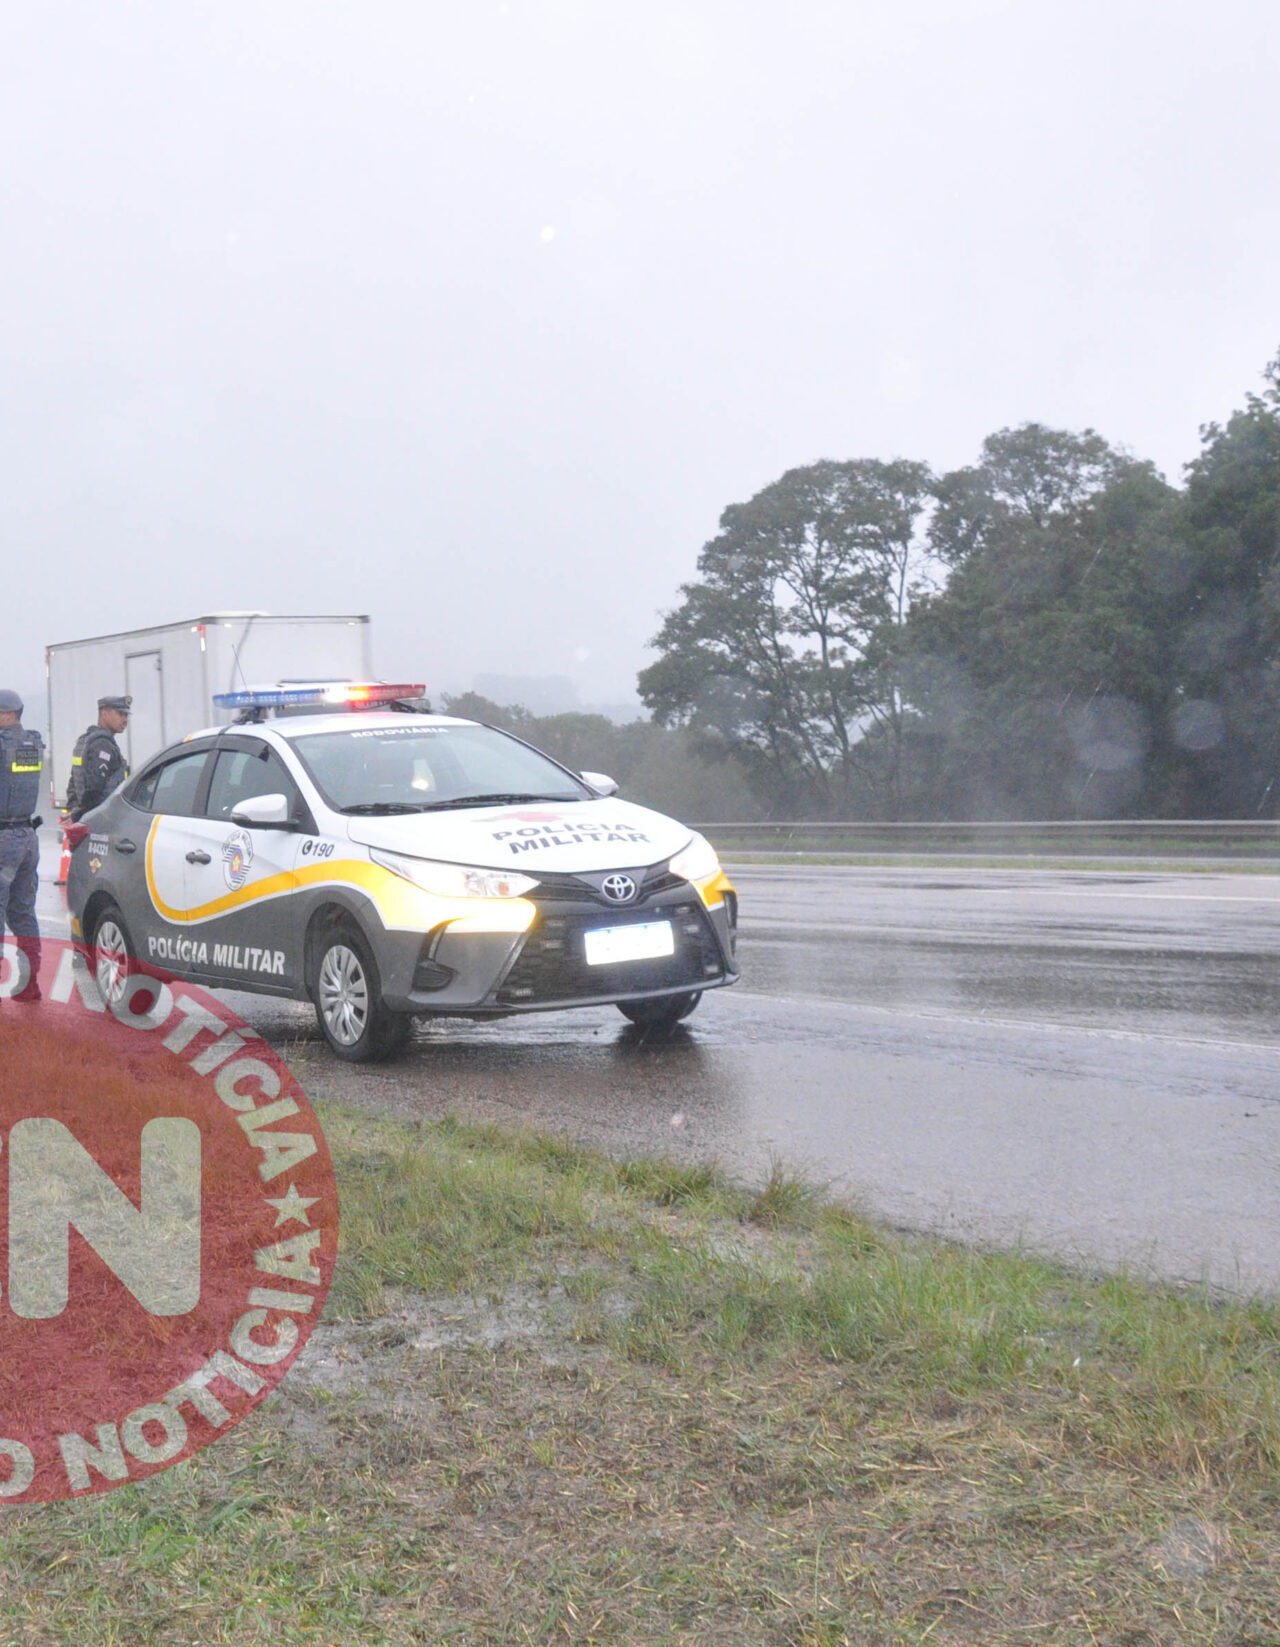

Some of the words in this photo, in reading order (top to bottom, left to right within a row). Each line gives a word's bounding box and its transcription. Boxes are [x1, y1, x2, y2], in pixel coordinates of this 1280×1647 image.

[313, 843, 335, 858] 190
[509, 832, 651, 855] MILITAR
[148, 934, 209, 965] POLÍCIA
[213, 943, 286, 976] MILITAR
